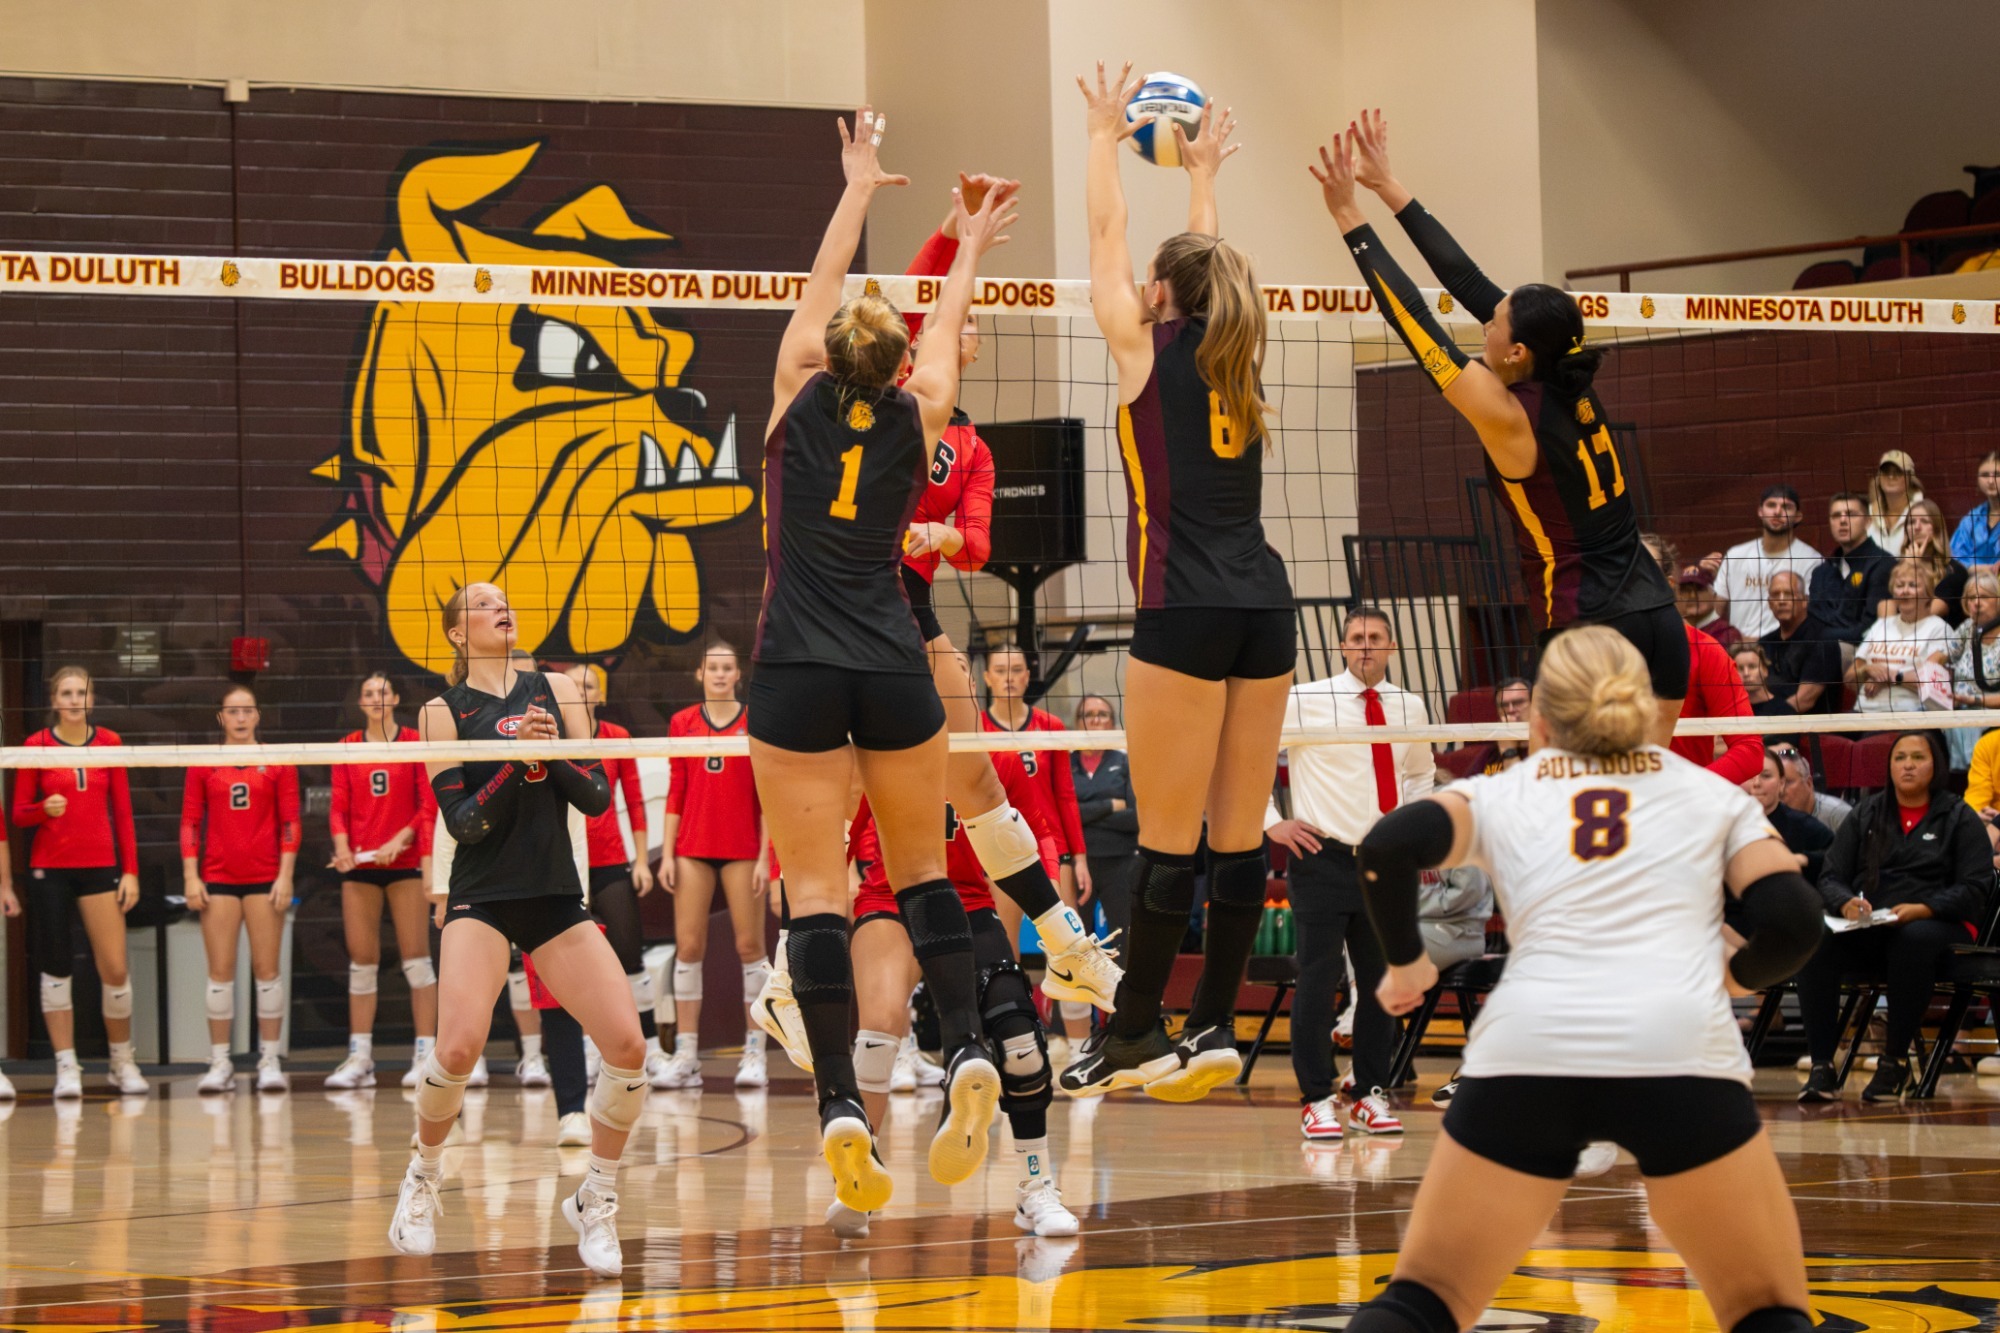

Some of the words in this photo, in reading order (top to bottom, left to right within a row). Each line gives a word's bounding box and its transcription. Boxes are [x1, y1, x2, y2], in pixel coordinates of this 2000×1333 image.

[50, 256, 179, 286] DULUTH
[279, 262, 435, 293] BULLDOGS
[530, 269, 703, 299] MINNESOTA
[712, 275, 808, 301] DULUT
[1302, 289, 1373, 313] DULU
[1686, 297, 1824, 322] MINNESOTA
[1830, 301, 1923, 324] DULUTH
[829, 444, 864, 521] 1
[992, 484, 1046, 499] KTRONICS
[487, 762, 515, 795] CLOUD
[1536, 751, 1663, 781] BULLDOGS
[230, 782, 250, 810] 2
[369, 769, 389, 797] 9
[1570, 787, 1631, 863] 8
